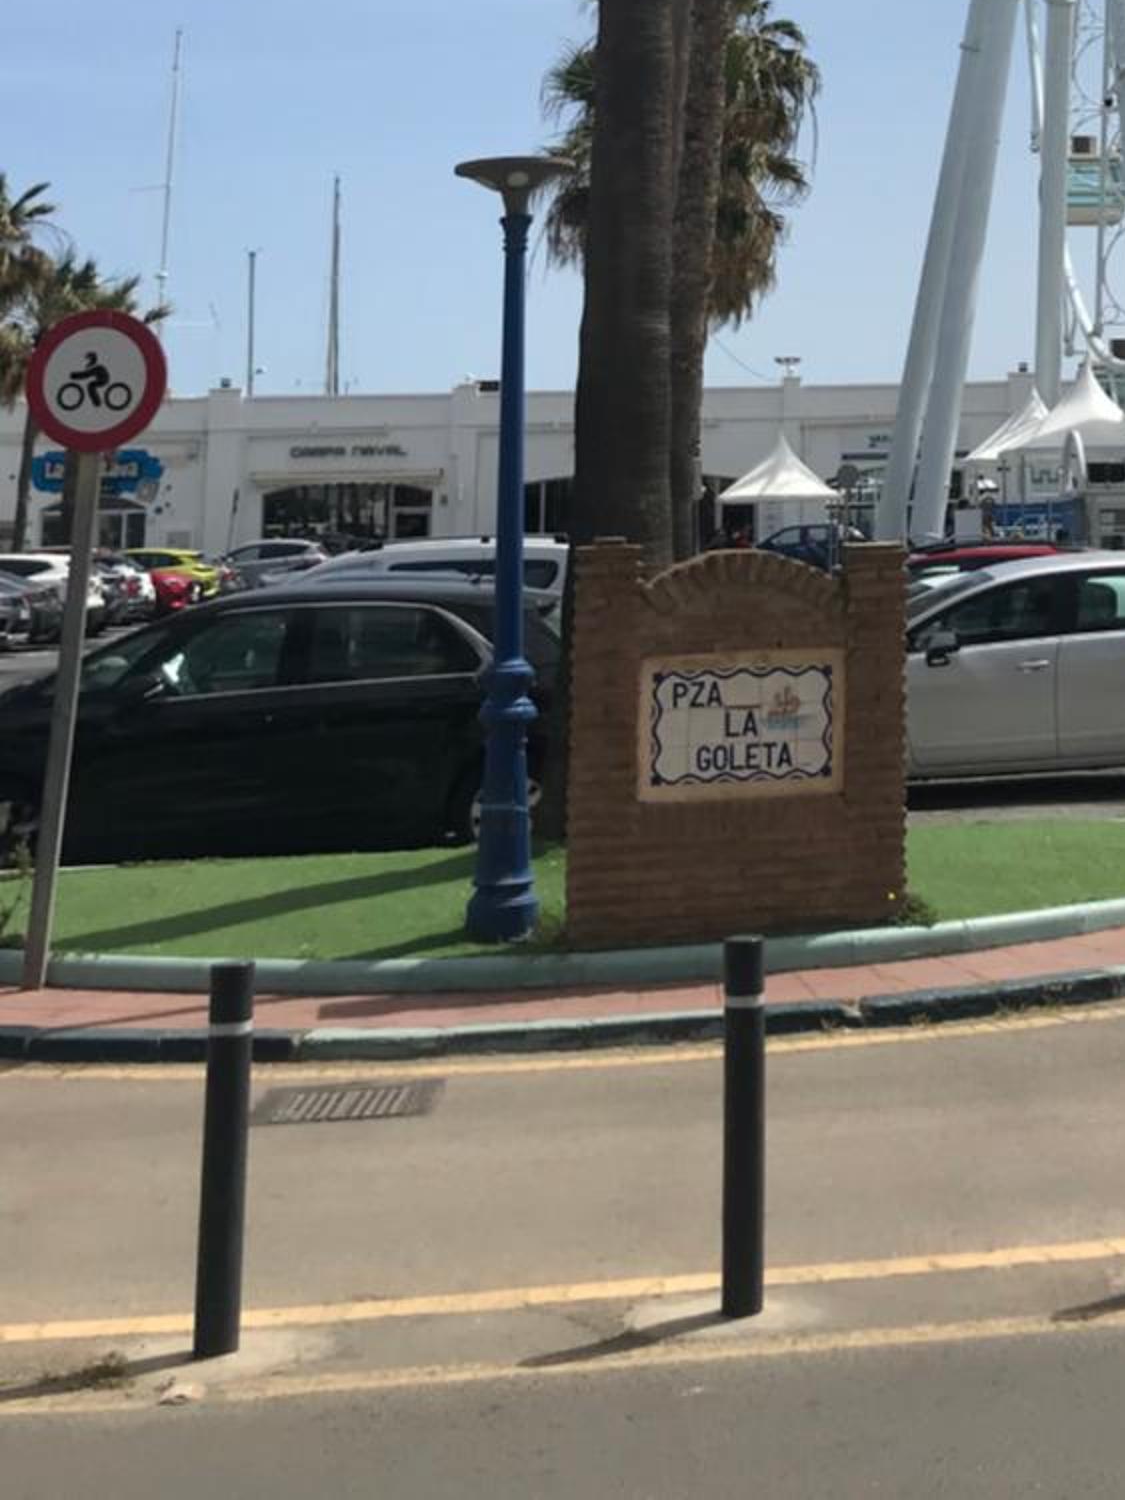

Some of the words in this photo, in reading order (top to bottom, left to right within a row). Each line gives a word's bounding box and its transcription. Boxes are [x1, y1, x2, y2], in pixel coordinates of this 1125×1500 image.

[672, 680, 722, 709] PZA
[724, 711, 758, 737] LA
[696, 742, 793, 771] GOLETA
